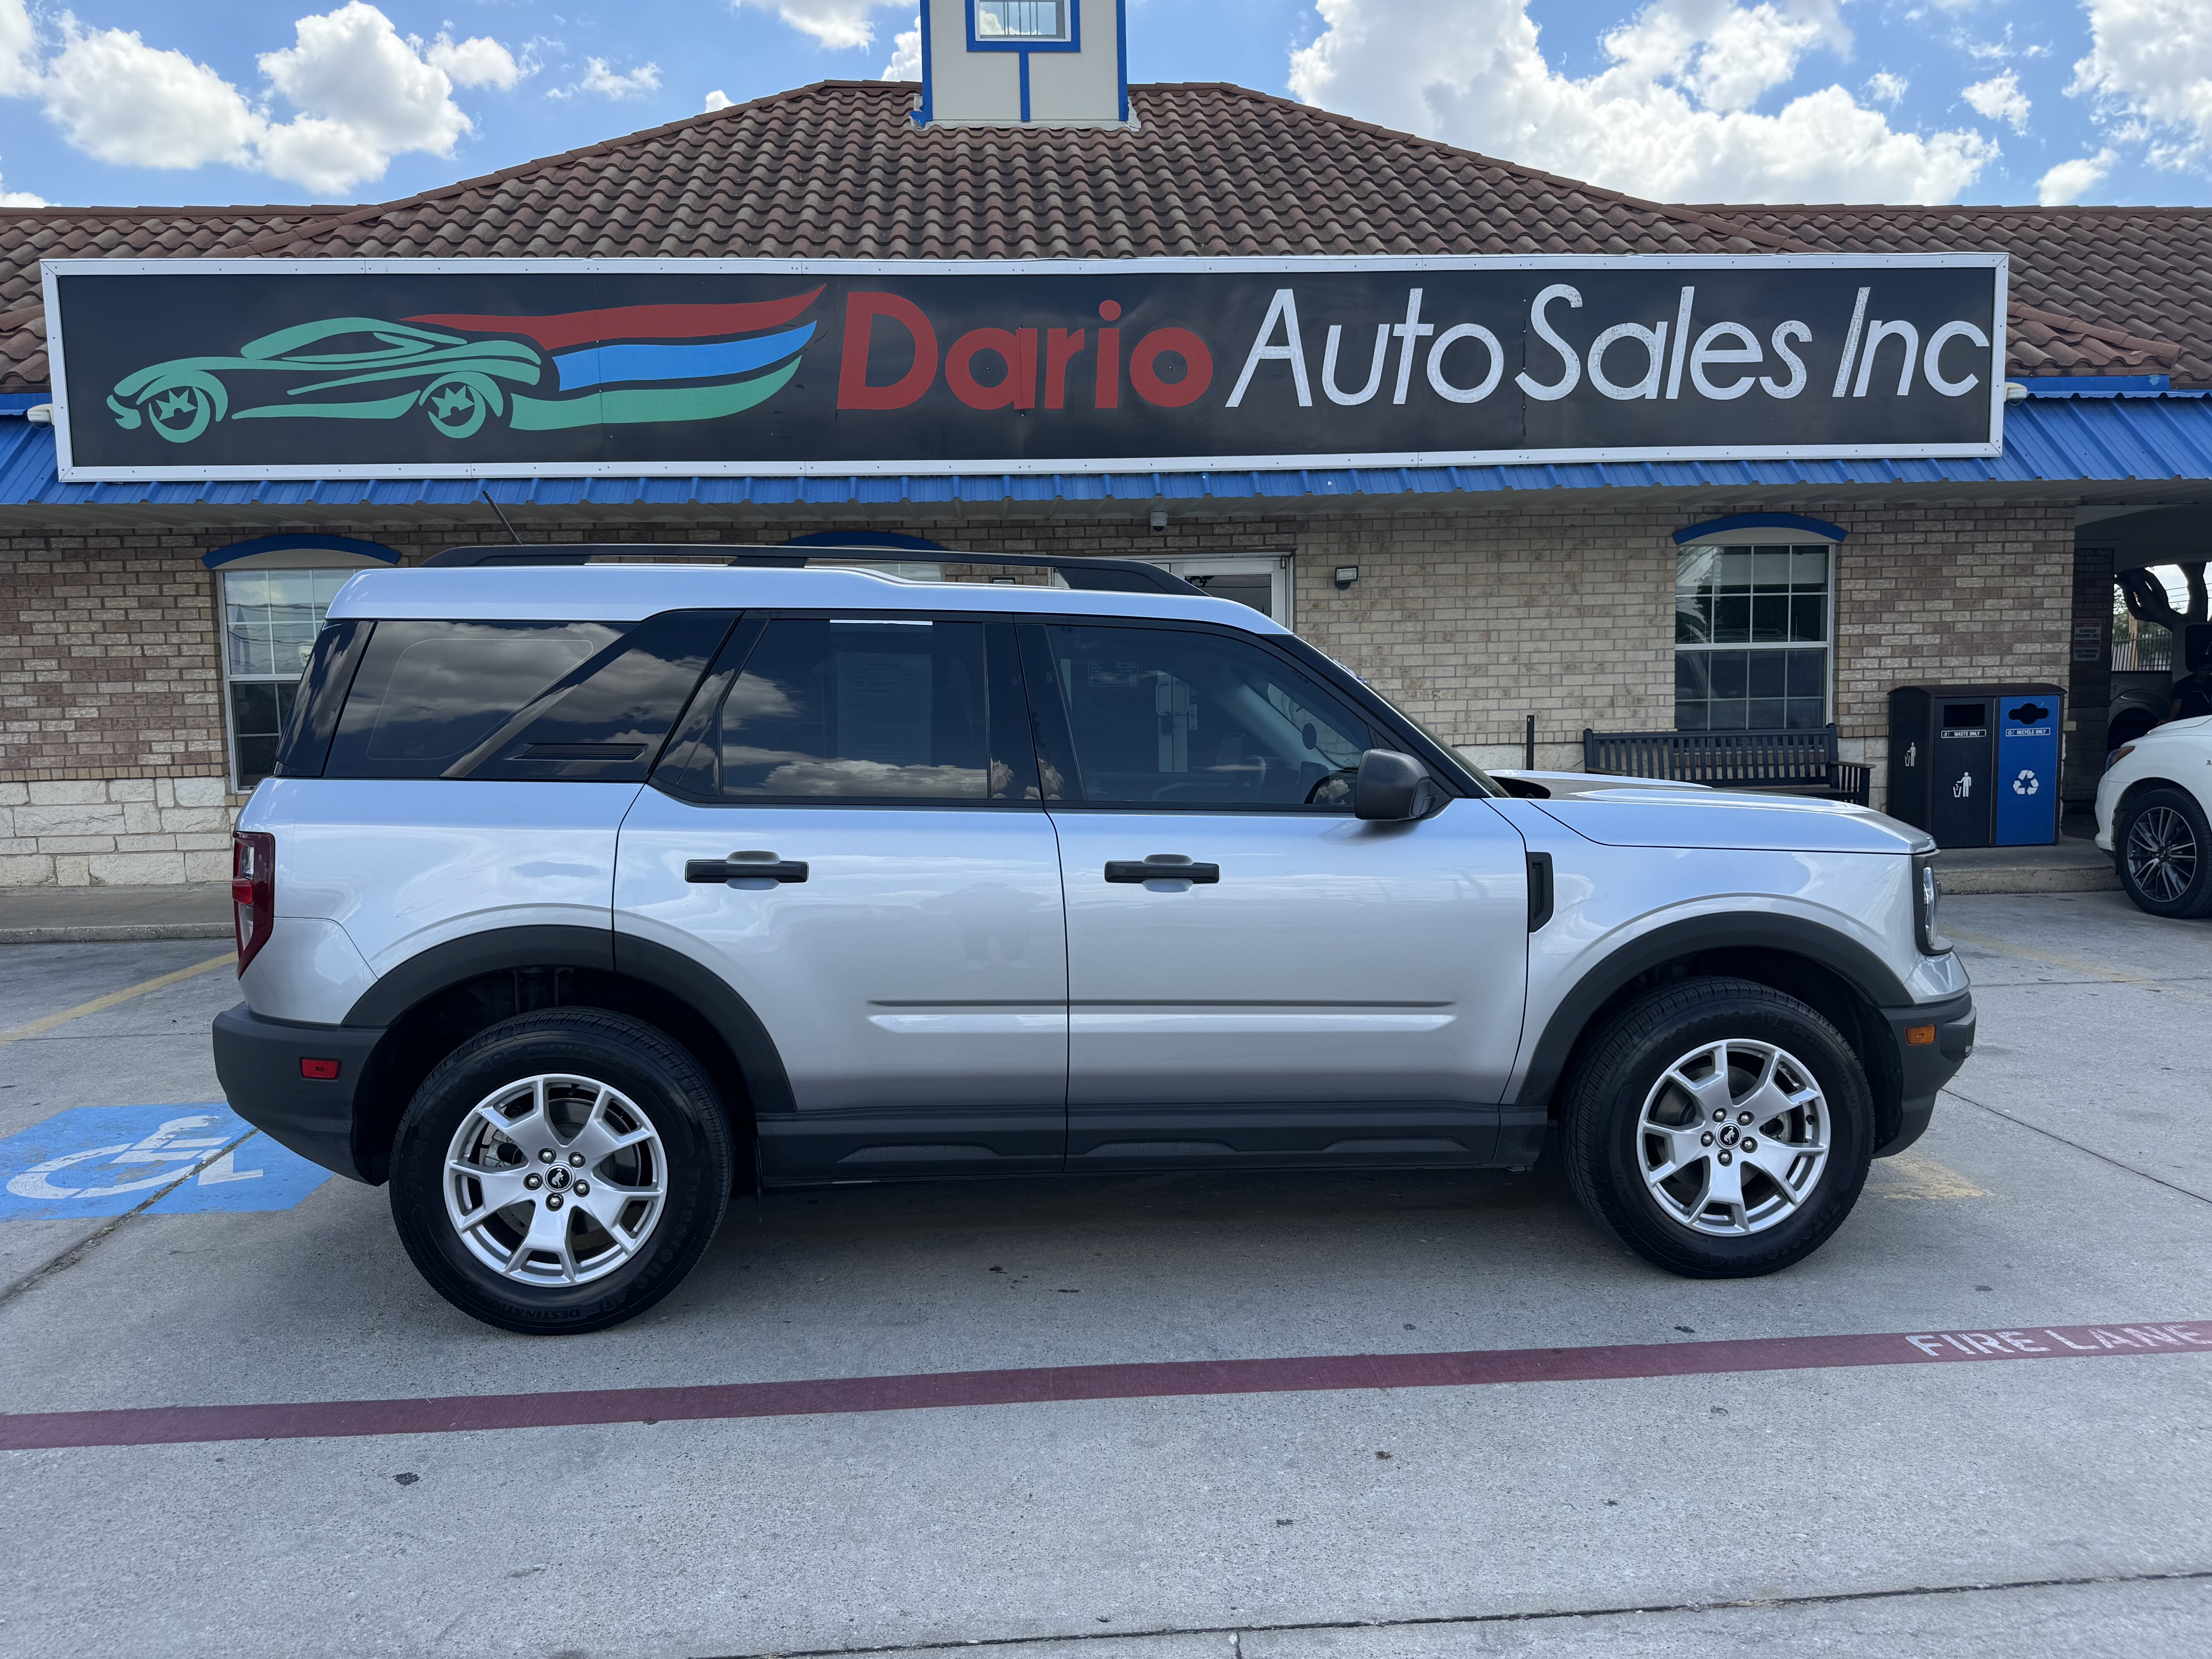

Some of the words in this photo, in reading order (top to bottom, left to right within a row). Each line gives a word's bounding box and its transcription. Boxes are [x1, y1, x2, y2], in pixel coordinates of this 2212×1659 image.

[838, 293, 1212, 409] Dario
[1225, 289, 1504, 407] Auto
[1515, 284, 1812, 400] Sales
[1832, 287, 1989, 397] Inc
[632, 1166, 701, 1292] Firestone
[1733, 1196, 1843, 1268] Firestone
[1905, 1331, 2051, 1356] FIRE
[2044, 1325, 2212, 1349] LANE
